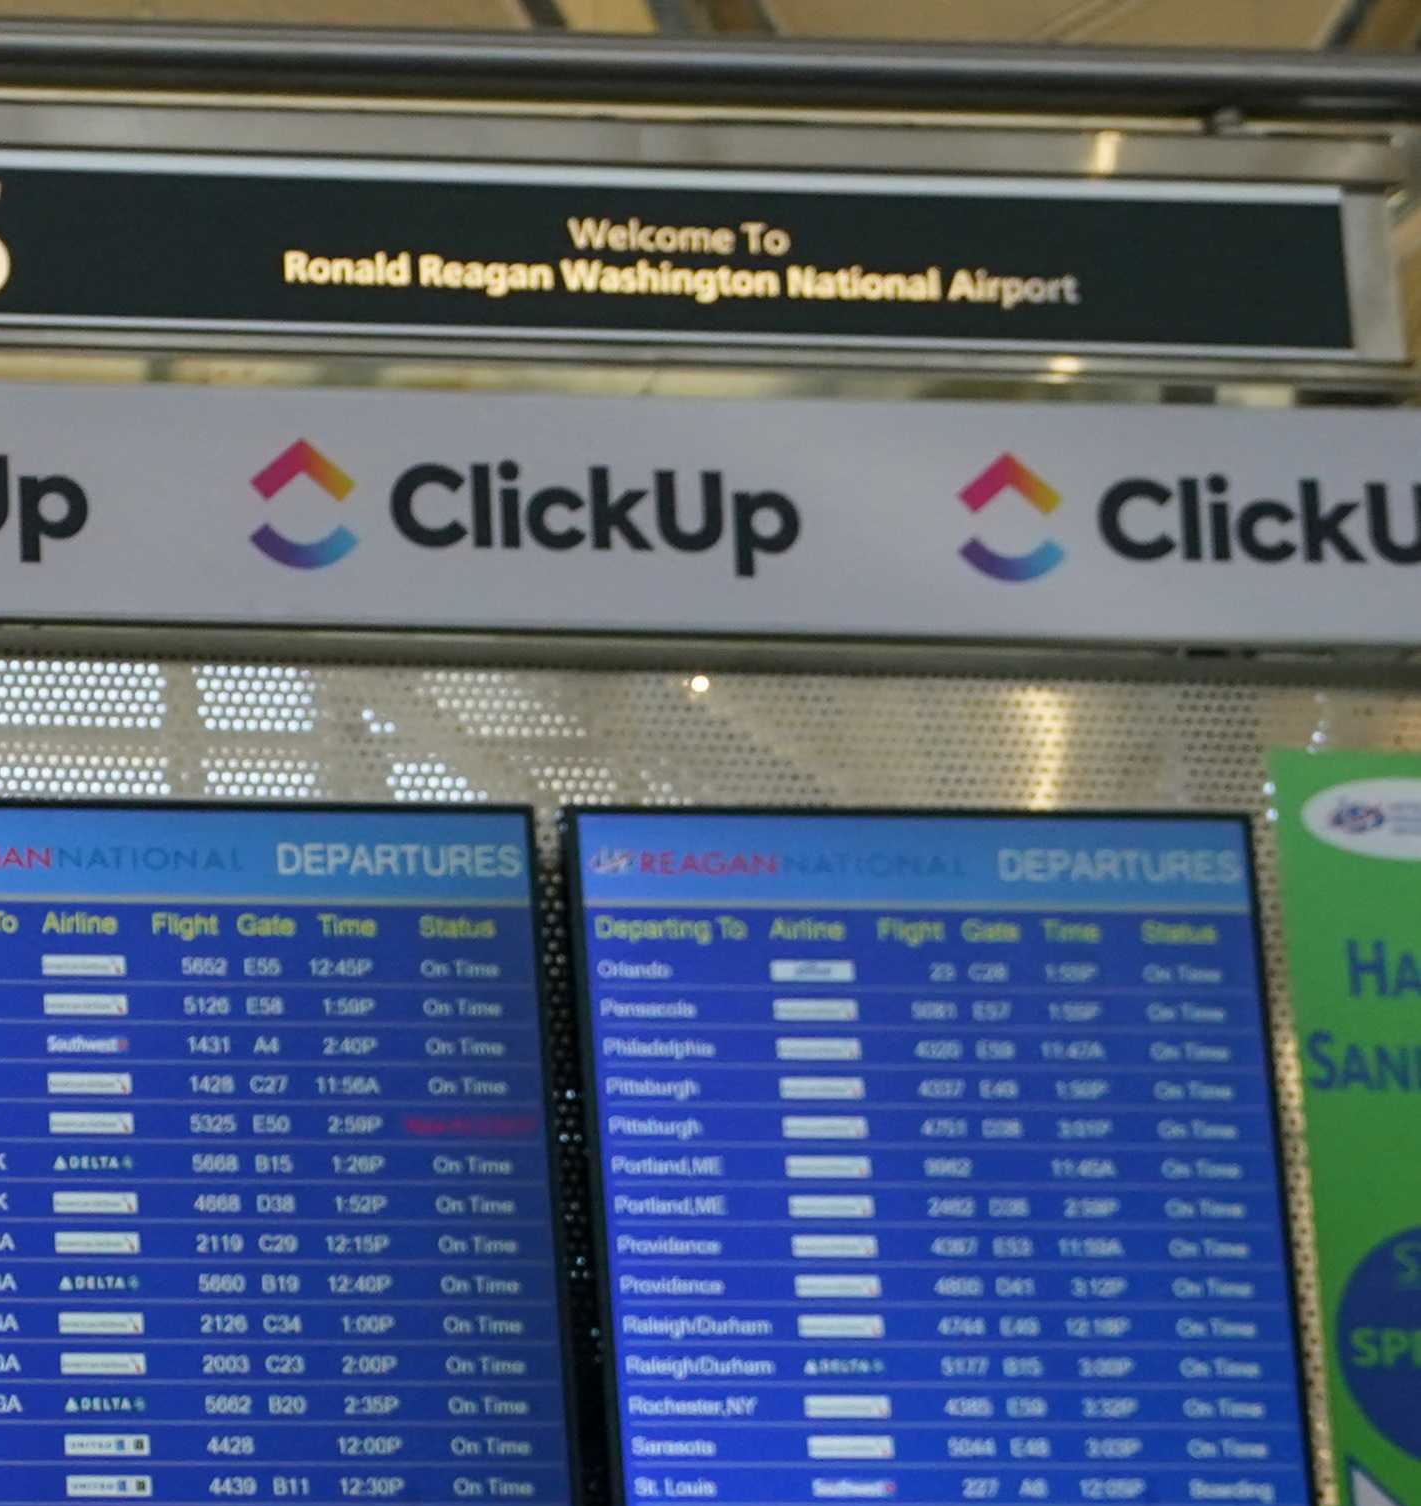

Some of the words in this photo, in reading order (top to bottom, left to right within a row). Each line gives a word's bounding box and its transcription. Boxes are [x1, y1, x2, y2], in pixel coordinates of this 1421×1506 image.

[567, 218, 735, 254] Welcome
[741, 223, 790, 255] To
[284, 251, 411, 286] Ronald
[419, 255, 554, 296] Reagan
[560, 259, 780, 303] Washington
[787, 266, 941, 300] National
[948, 269, 1076, 308] Airport
[390, 460, 800, 578] ClickUp
[58, 846, 242, 871] NATIONAL
[277, 842, 521, 876] DEPARTURES
[998, 848, 1242, 883] DEPARTURES
[42, 912, 118, 935] Airline
[152, 912, 218, 941] Flight
[237, 913, 296, 936] Gate
[317, 914, 377, 937] Time
[419, 915, 496, 938] Status
[595, 915, 712, 944] Departing
[716, 916, 747, 940] To
[770, 918, 845, 941] Airline
[877, 917, 944, 947] Flight
[961, 919, 1020, 942] Gate
[1043, 919, 1101, 943] Time
[1141, 920, 1217, 944] Status
[254, 1037, 279, 1053] A4
